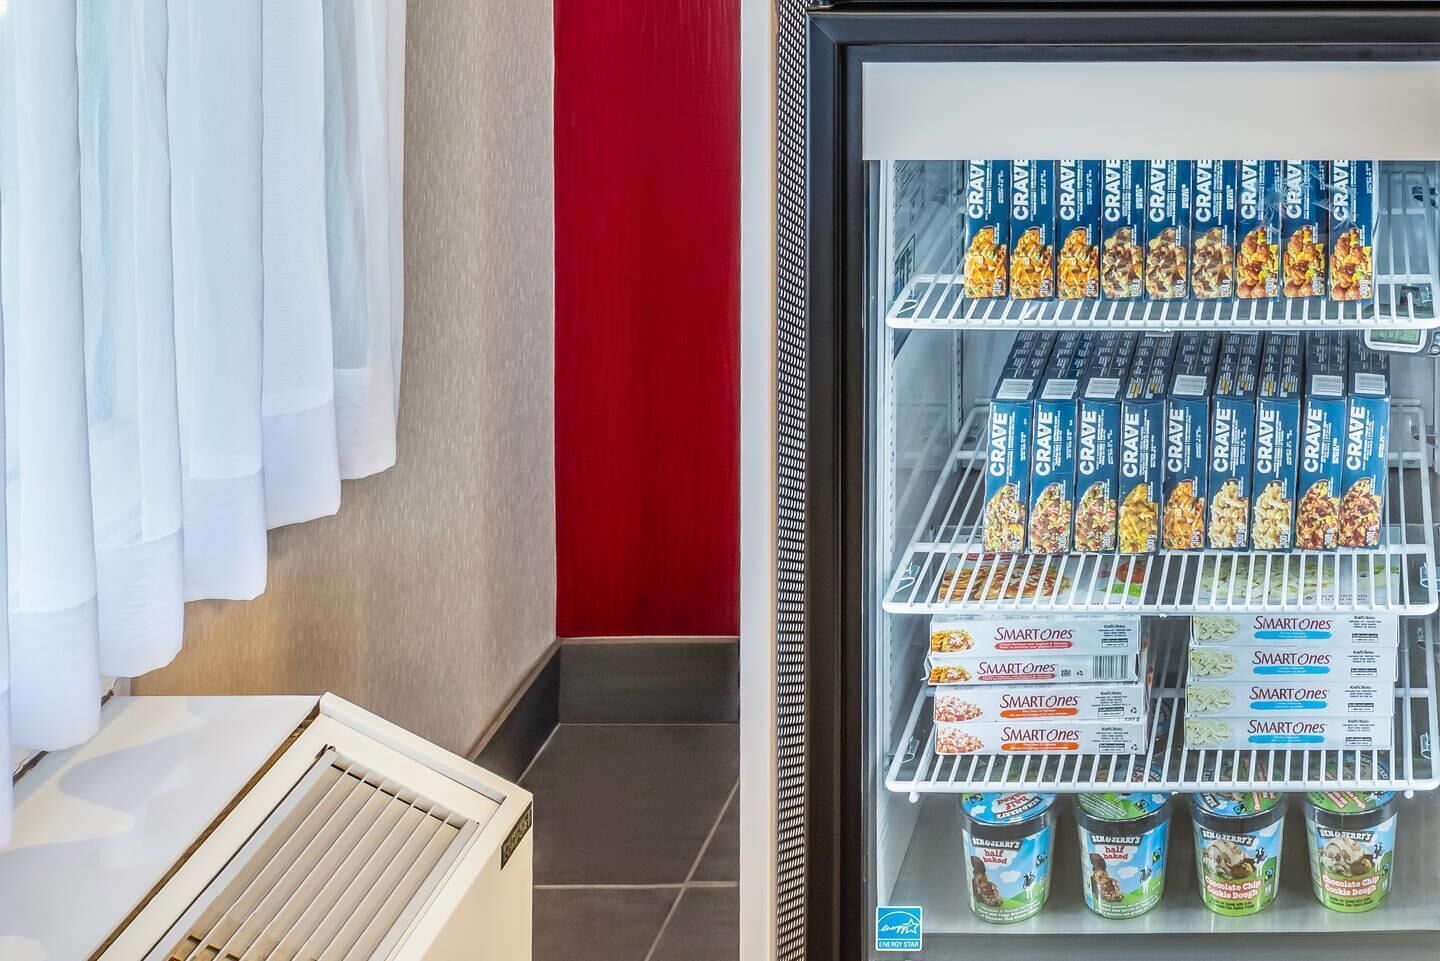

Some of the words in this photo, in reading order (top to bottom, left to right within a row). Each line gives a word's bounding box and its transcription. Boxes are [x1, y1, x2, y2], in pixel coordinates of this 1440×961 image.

[989, 413, 1009, 477] CRAVE
[1035, 411, 1053, 476] CRAVE
[1079, 411, 1097, 476] CRAVE
[1122, 412, 1140, 478] CRAVE
[1167, 409, 1185, 473] CRAVE
[1213, 408, 1231, 473] CRAVE
[1257, 409, 1275, 474] CRAVE
[1303, 408, 1322, 473] CRAVE
[1346, 406, 1366, 471] CRAVE
[983, 849, 1005, 858] half
[1102, 852, 1129, 861] baked
[1104, 845, 1124, 854] half
[1322, 874, 1360, 889] Chocolate
[1359, 876, 1380, 888] Chip
[1204, 876, 1242, 892] Chocolate
[1241, 879, 1262, 891] Chip
[1207, 887, 1233, 899] Cookie
[1233, 889, 1259, 901] Dough
[1324, 886, 1350, 896] Cookie
[1350, 884, 1377, 896] Dough
